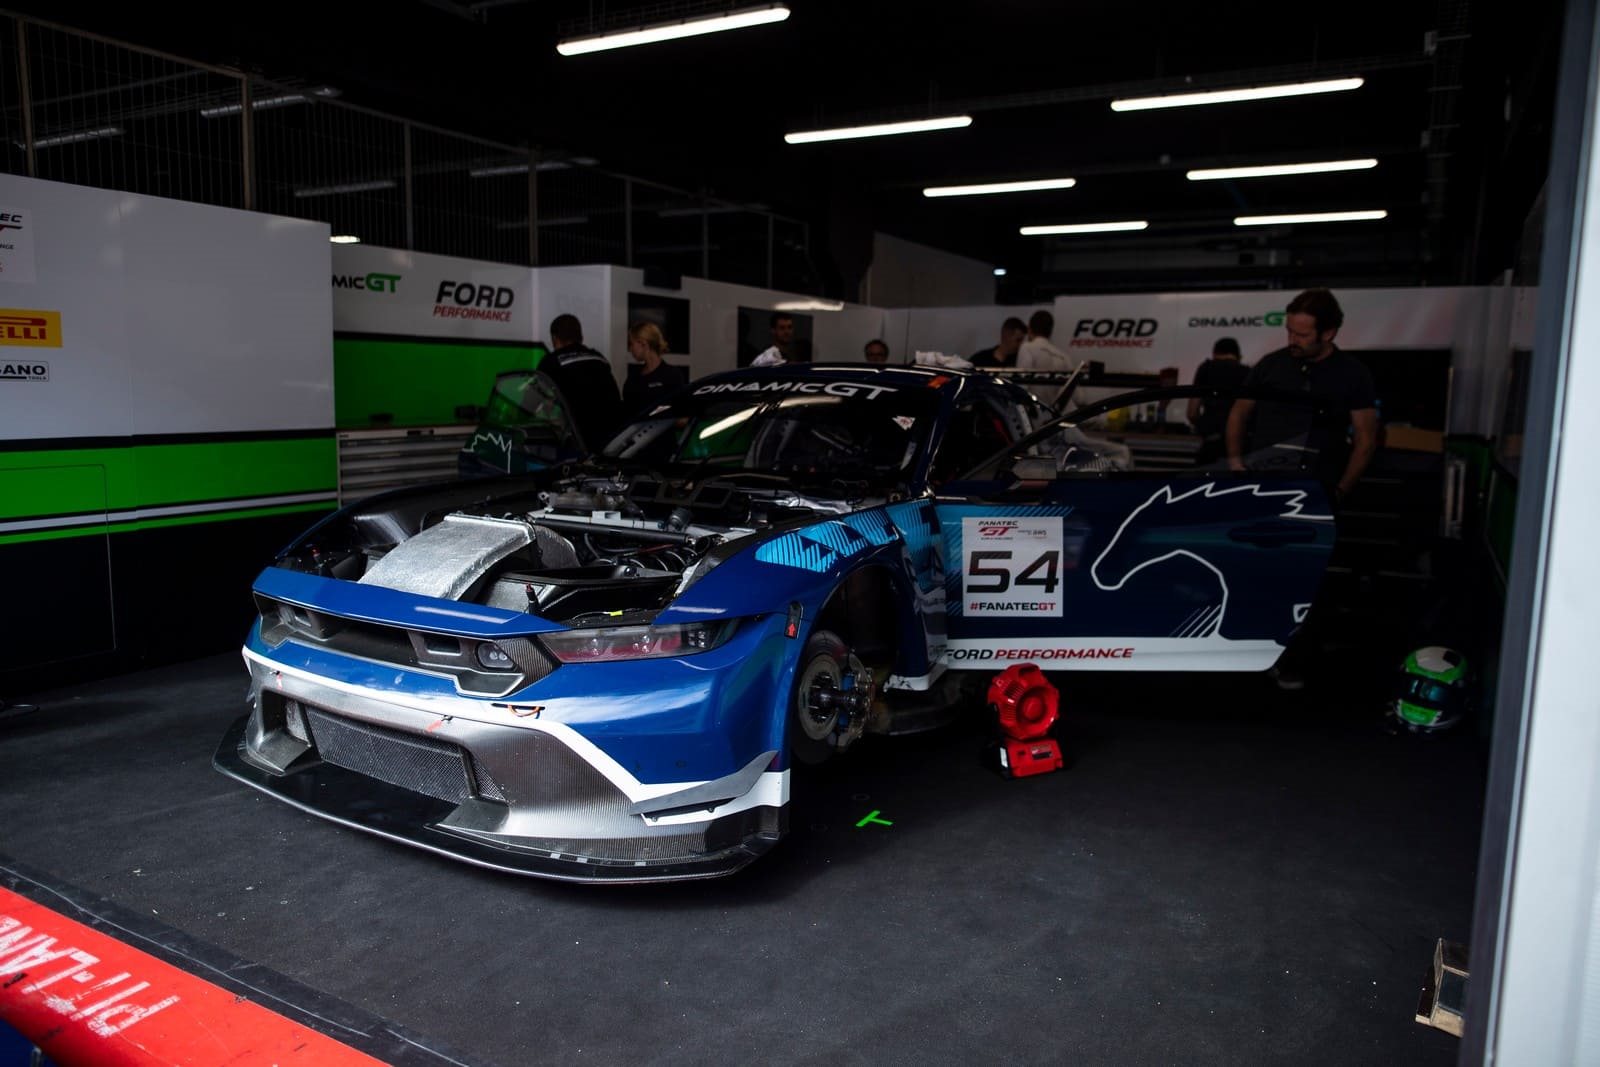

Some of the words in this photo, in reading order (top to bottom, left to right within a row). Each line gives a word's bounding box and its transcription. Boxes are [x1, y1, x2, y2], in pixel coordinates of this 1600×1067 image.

[436, 281, 514, 308] FORD
[433, 305, 512, 322] PERFORMANCE
[1188, 312, 1286, 327] DINAMICG
[1074, 318, 1158, 337] FORD
[1071, 339, 1153, 347] PERFORMANCE
[0, 364, 46, 375] ANO
[966, 551, 1059, 593] 54
[970, 602, 1056, 611] #FANATECGT
[944, 649, 993, 660] FORD
[994, 648, 1134, 660] PERFORMANCE
[0, 915, 181, 1038] PIT-LAN
